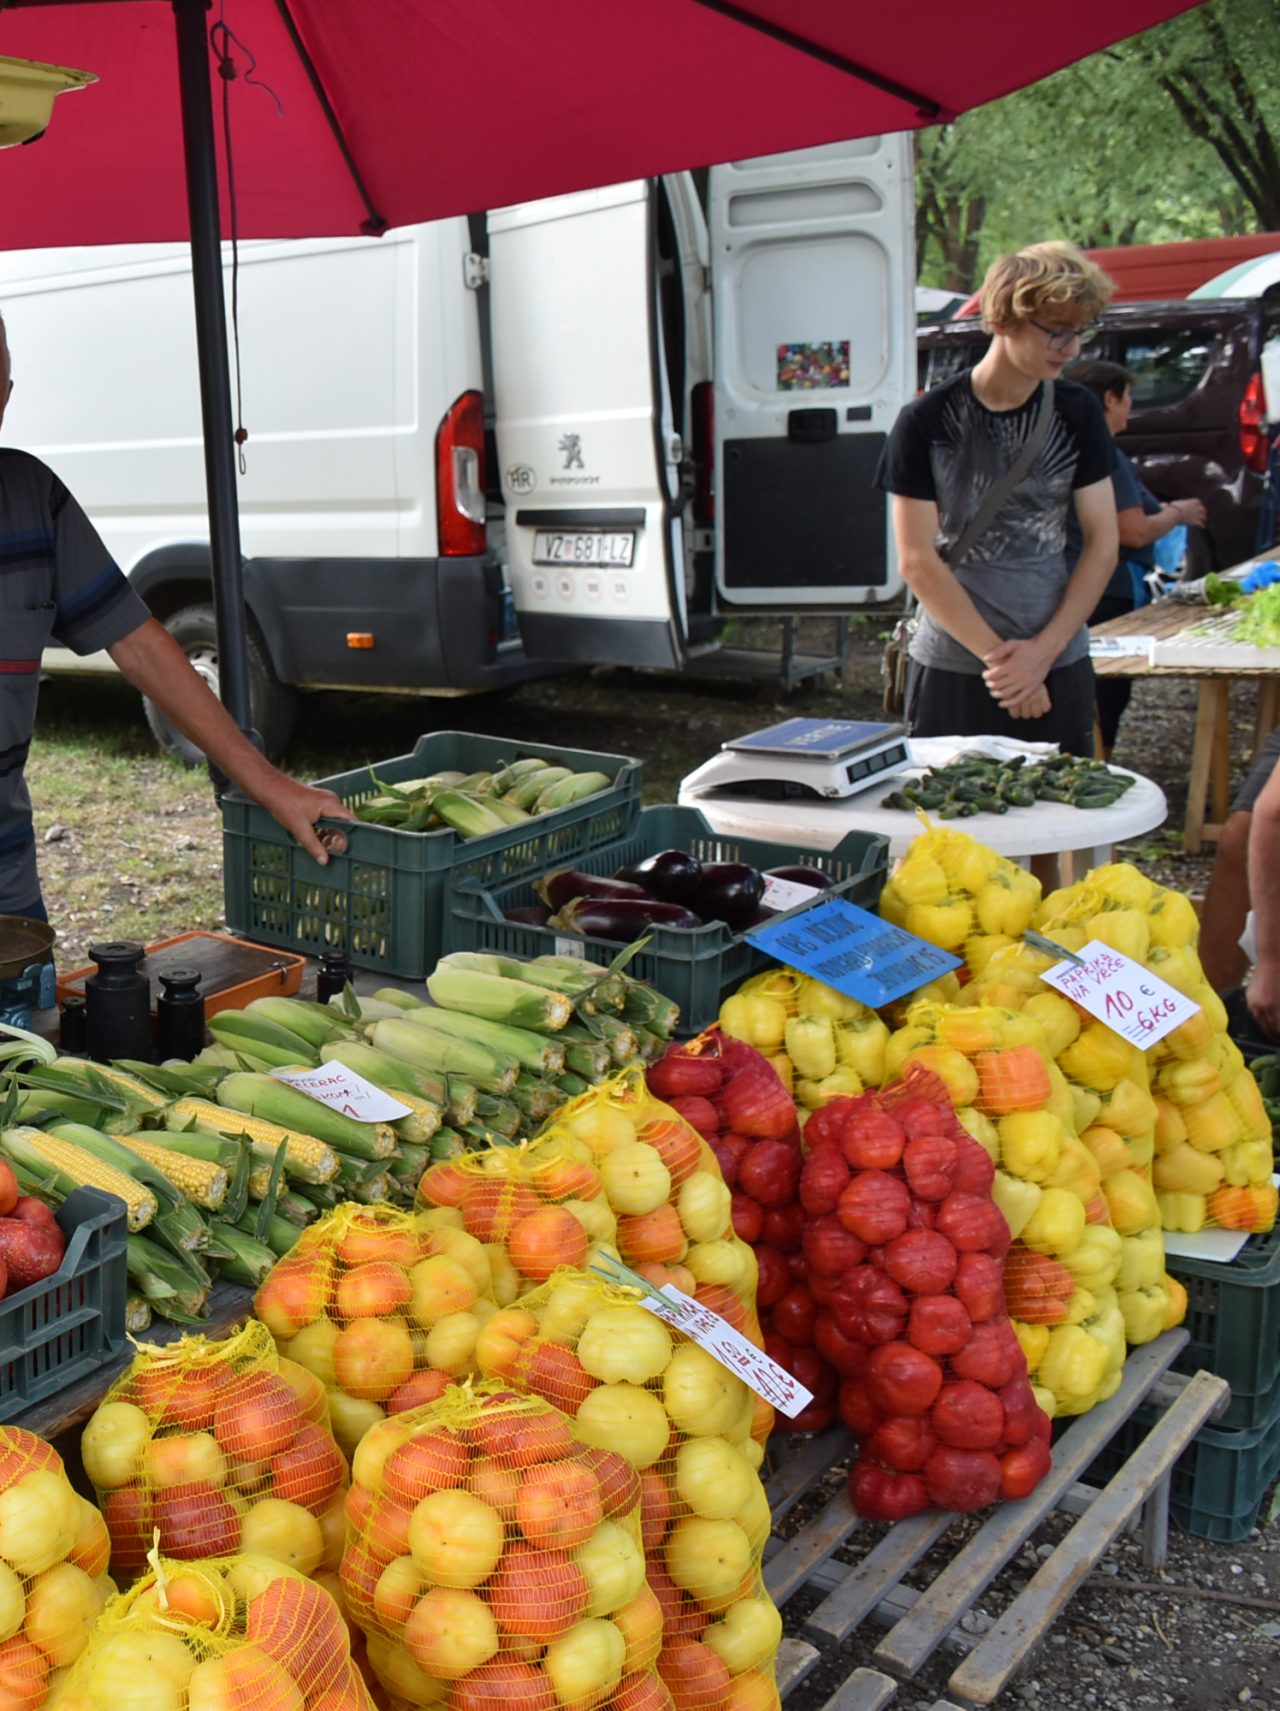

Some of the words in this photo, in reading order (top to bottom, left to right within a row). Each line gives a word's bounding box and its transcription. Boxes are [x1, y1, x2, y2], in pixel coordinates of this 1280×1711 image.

[510, 471, 531, 488] HR
[545, 536, 563, 558] VZ
[1061, 953, 1114, 989] PAPRIKA
[1105, 990, 1133, 1019] 10
